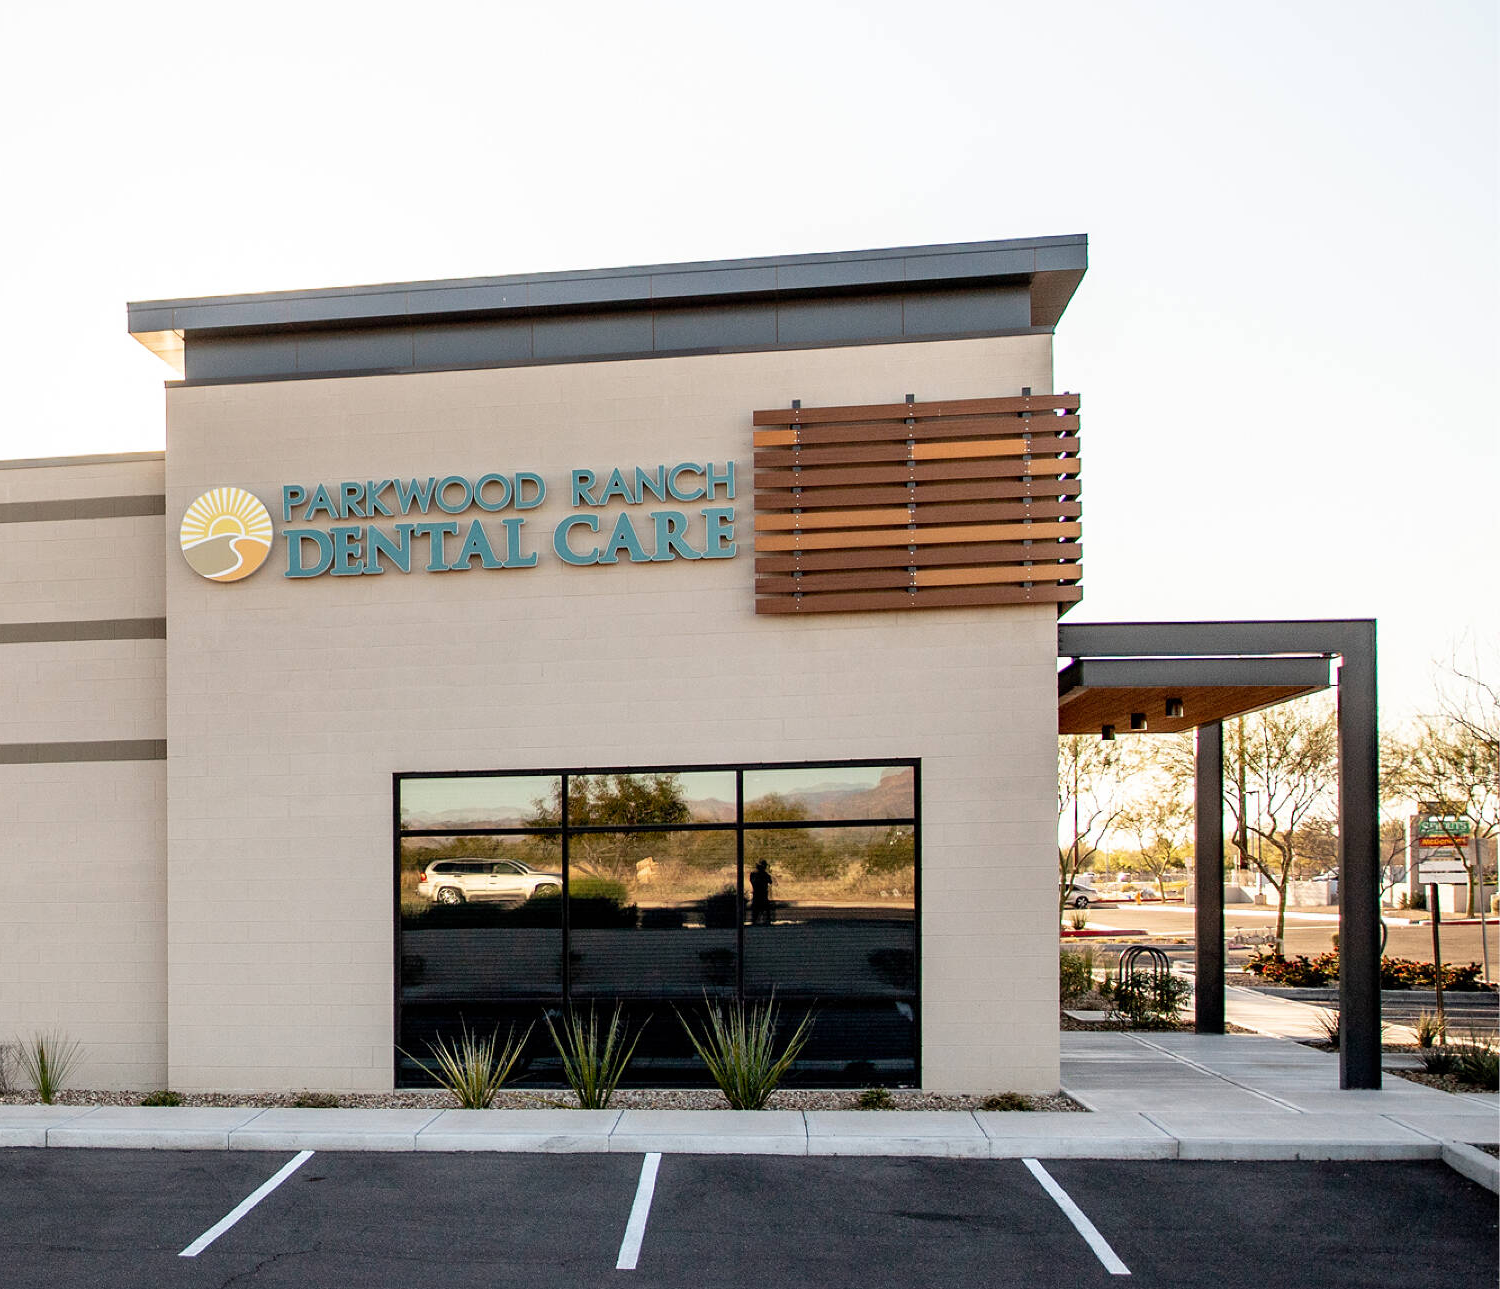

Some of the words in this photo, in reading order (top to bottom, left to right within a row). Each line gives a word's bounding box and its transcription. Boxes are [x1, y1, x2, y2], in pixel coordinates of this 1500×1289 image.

[281, 471, 547, 522] PARKWOOD
[570, 460, 736, 507] RANCH
[281, 517, 539, 579] DENTAL
[552, 506, 738, 566] CARE
